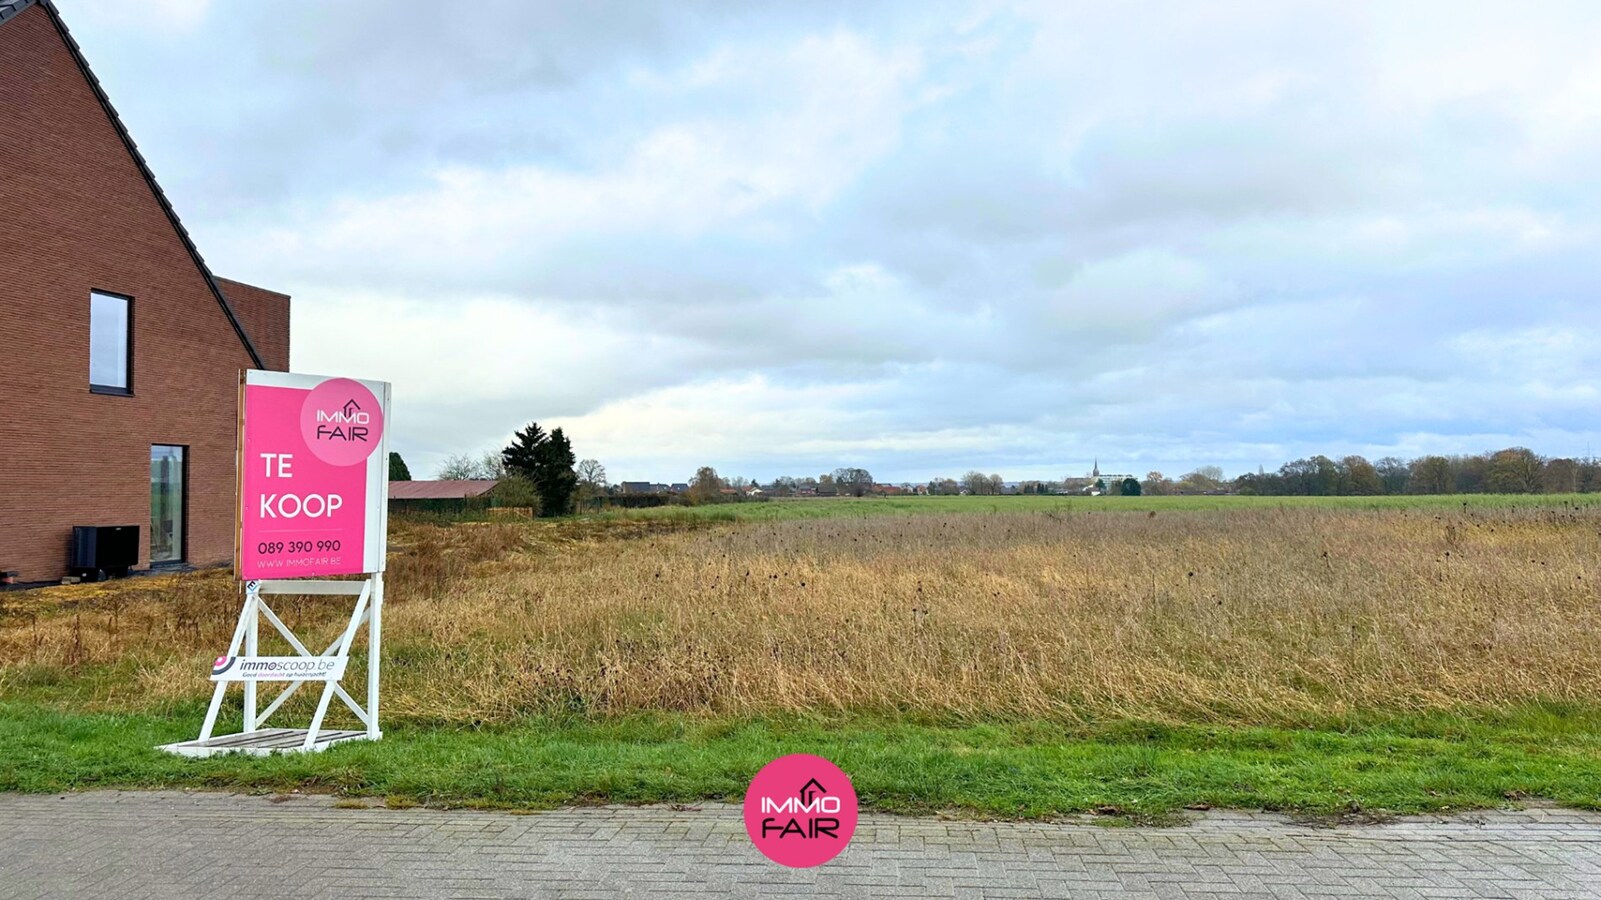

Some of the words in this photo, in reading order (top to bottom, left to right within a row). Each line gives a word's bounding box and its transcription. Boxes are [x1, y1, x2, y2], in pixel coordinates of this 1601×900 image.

[316, 409, 370, 425] IMMO
[316, 424, 369, 442] FAIR
[260, 452, 294, 478] TE
[260, 493, 343, 518] KOOP
[257, 542, 284, 555] 089
[288, 540, 313, 553] 390
[316, 539, 341, 552] 990
[240, 658, 335, 672] immoscoop.be
